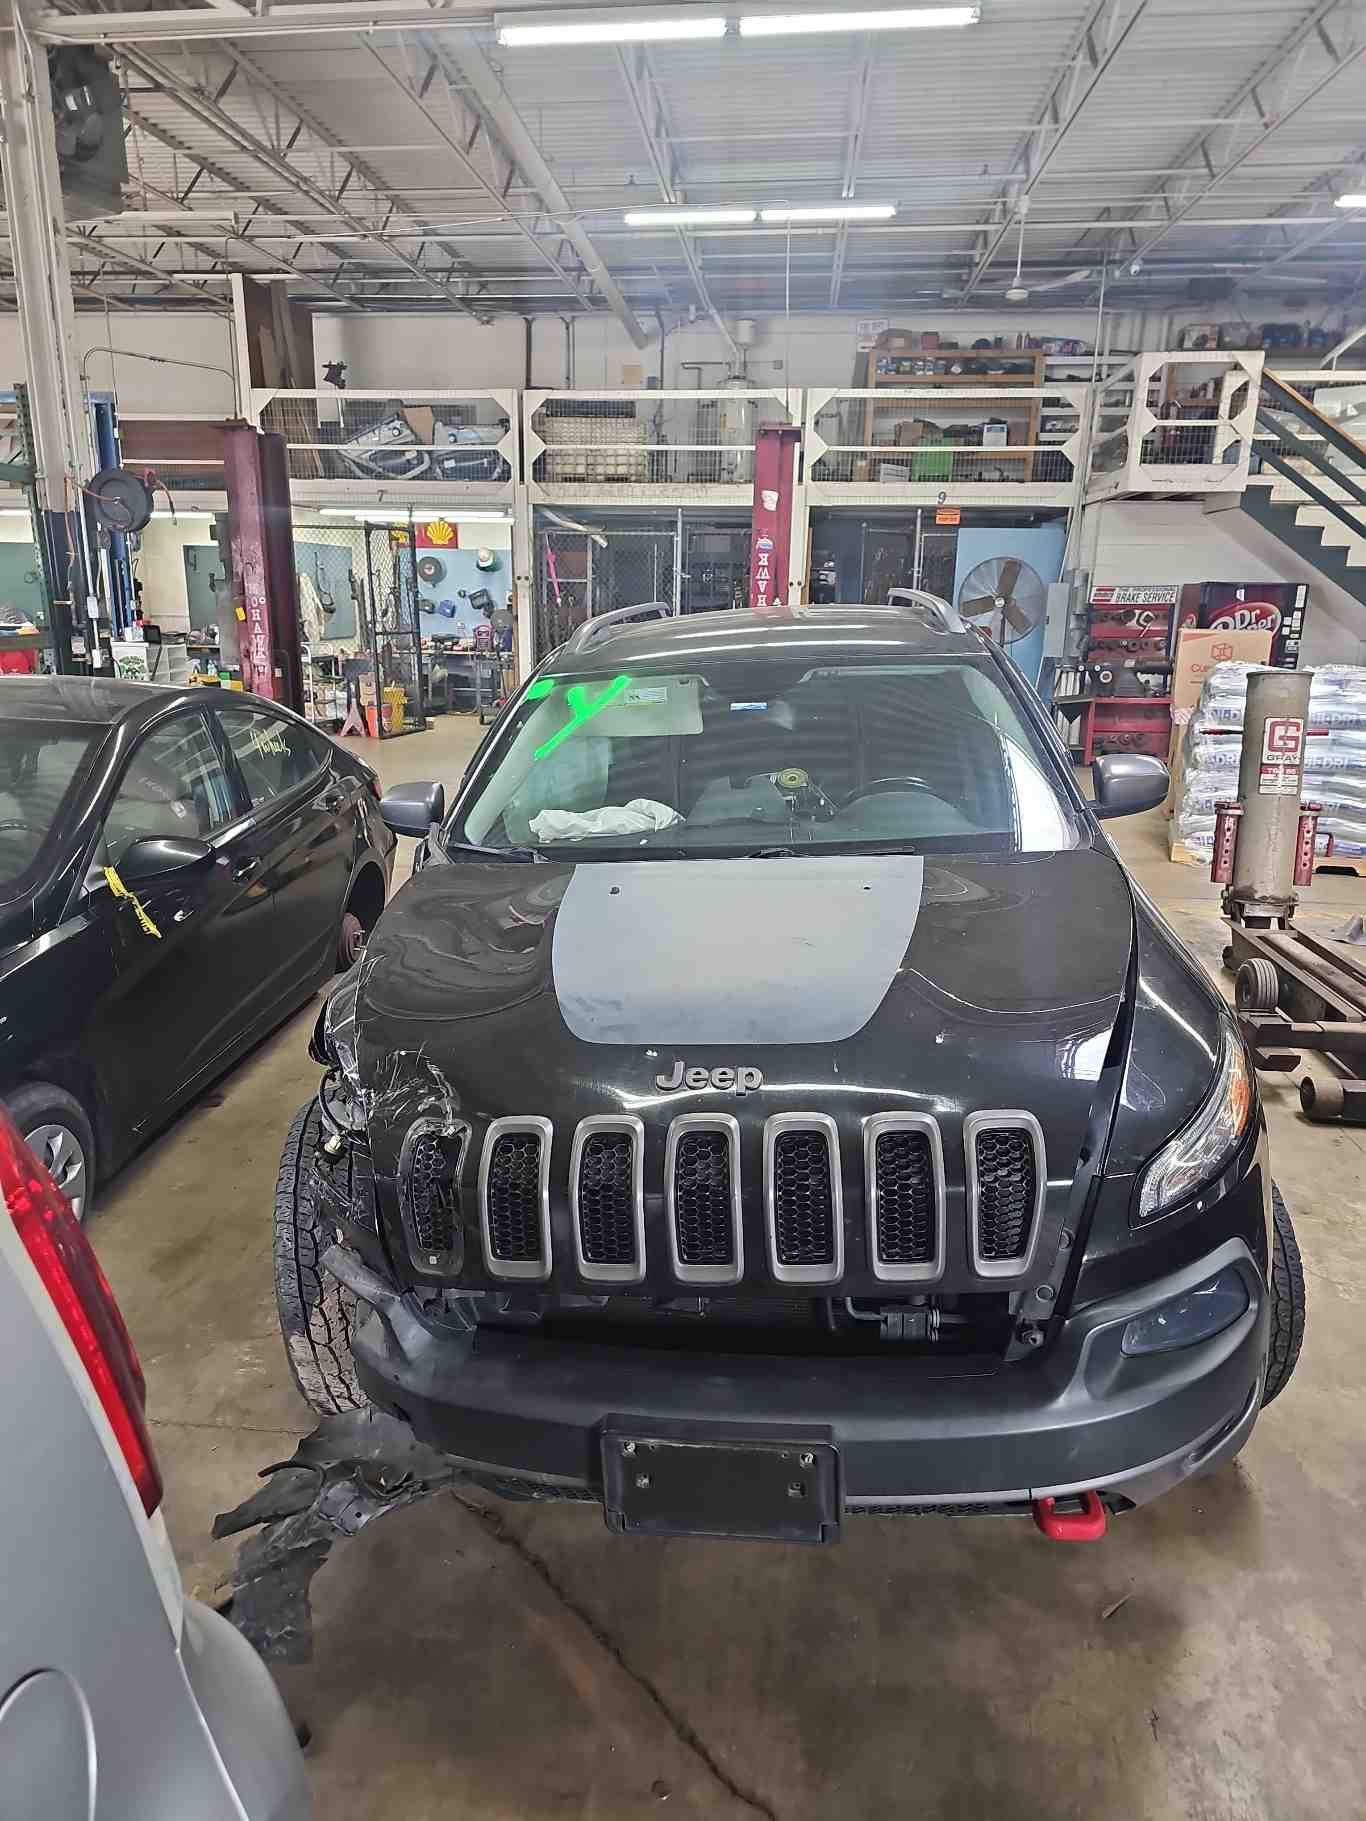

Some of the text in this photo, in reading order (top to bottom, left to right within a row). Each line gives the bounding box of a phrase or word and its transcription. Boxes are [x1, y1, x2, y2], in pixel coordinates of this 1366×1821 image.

[938, 491, 946, 504] 9
[1115, 591, 1142, 603] BRAKE
[1143, 591, 1175, 602] SERVICE
[1233, 609, 1261, 629] Dr
[1266, 754, 1298, 762] GRAY
[656, 1060, 763, 1096] Jeep
